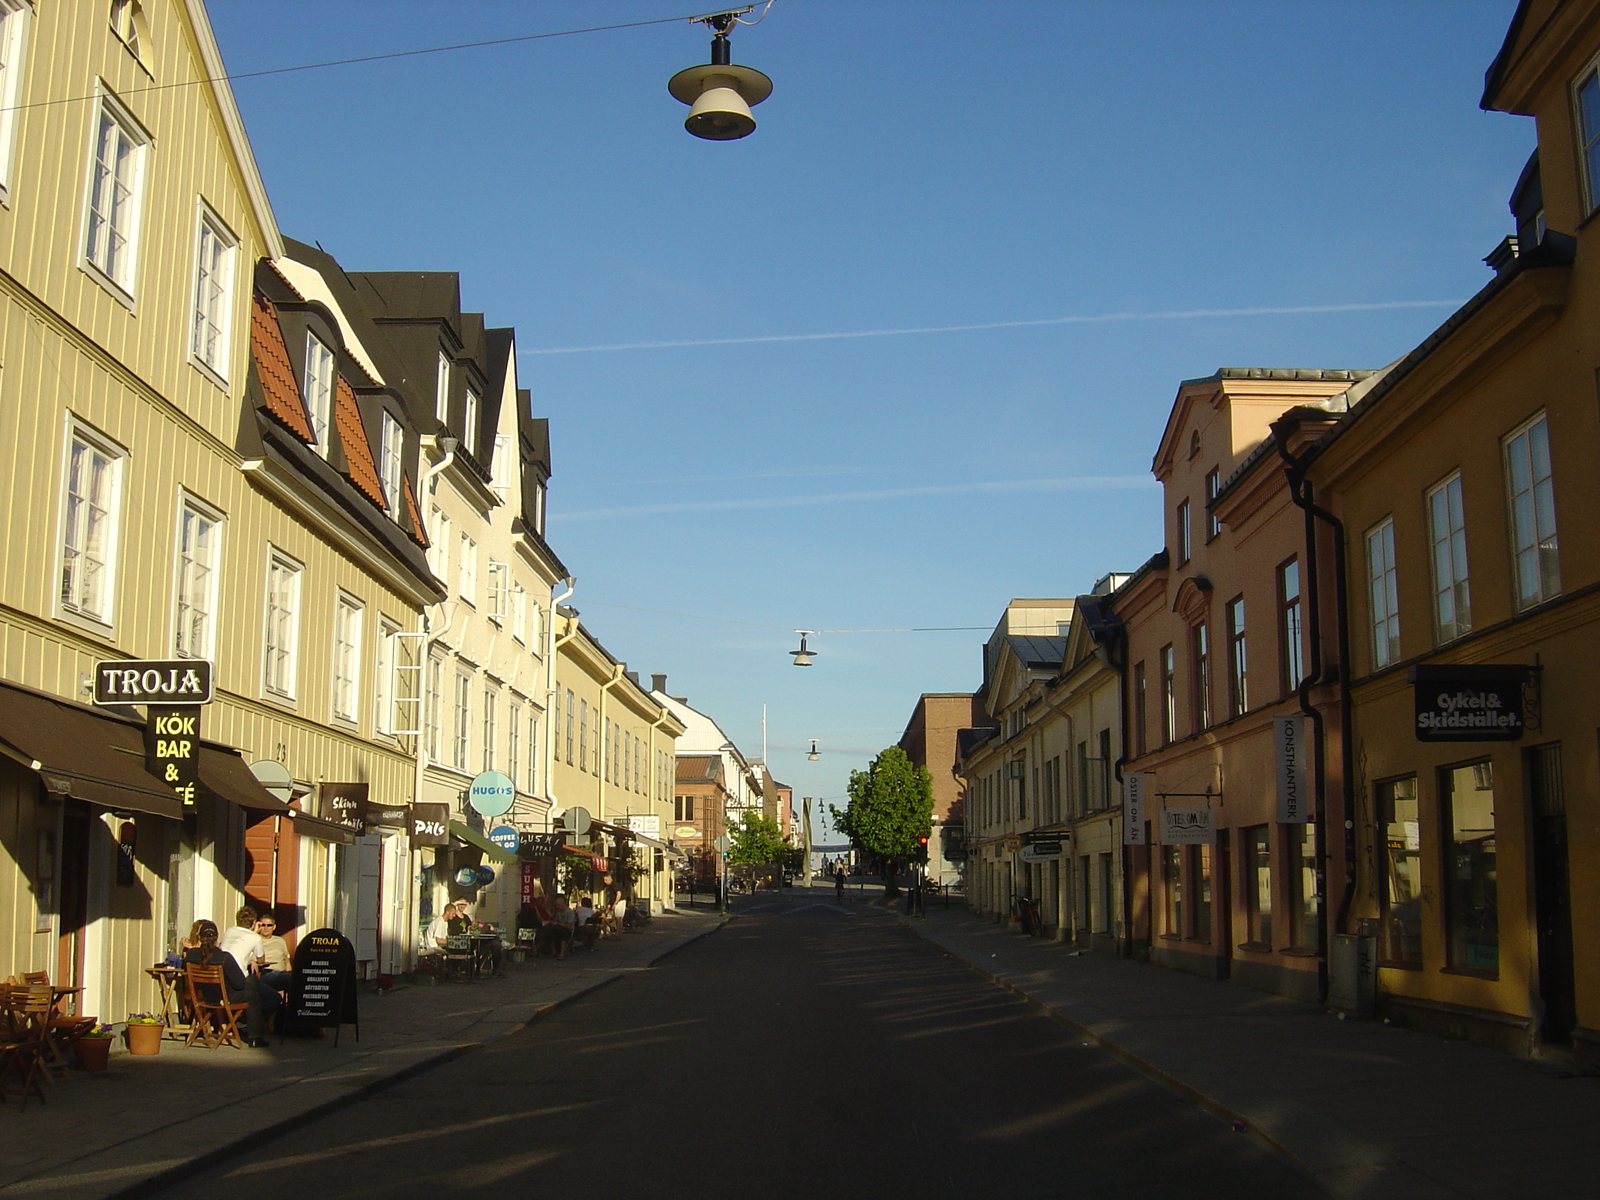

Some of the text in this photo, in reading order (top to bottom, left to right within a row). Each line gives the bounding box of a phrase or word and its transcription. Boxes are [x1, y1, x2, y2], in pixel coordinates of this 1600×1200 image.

[102, 669, 203, 696] TROJA
[155, 712, 196, 735] KÖK
[1418, 711, 1522, 728] Skidstället.
[156, 740, 192, 758] BAR
[276, 742, 287, 763] 23
[165, 763, 179, 782] &
[1284, 720, 1297, 818] KONSTHANTVERK
[332, 796, 358, 810] Skinn
[1130, 807, 1139, 823] OM
[414, 819, 445, 836] Päls
[490, 833, 516, 843] COFFEE
[504, 841, 516, 849] GO
[523, 864, 532, 904] SUSH
[311, 937, 340, 946] TROJA
